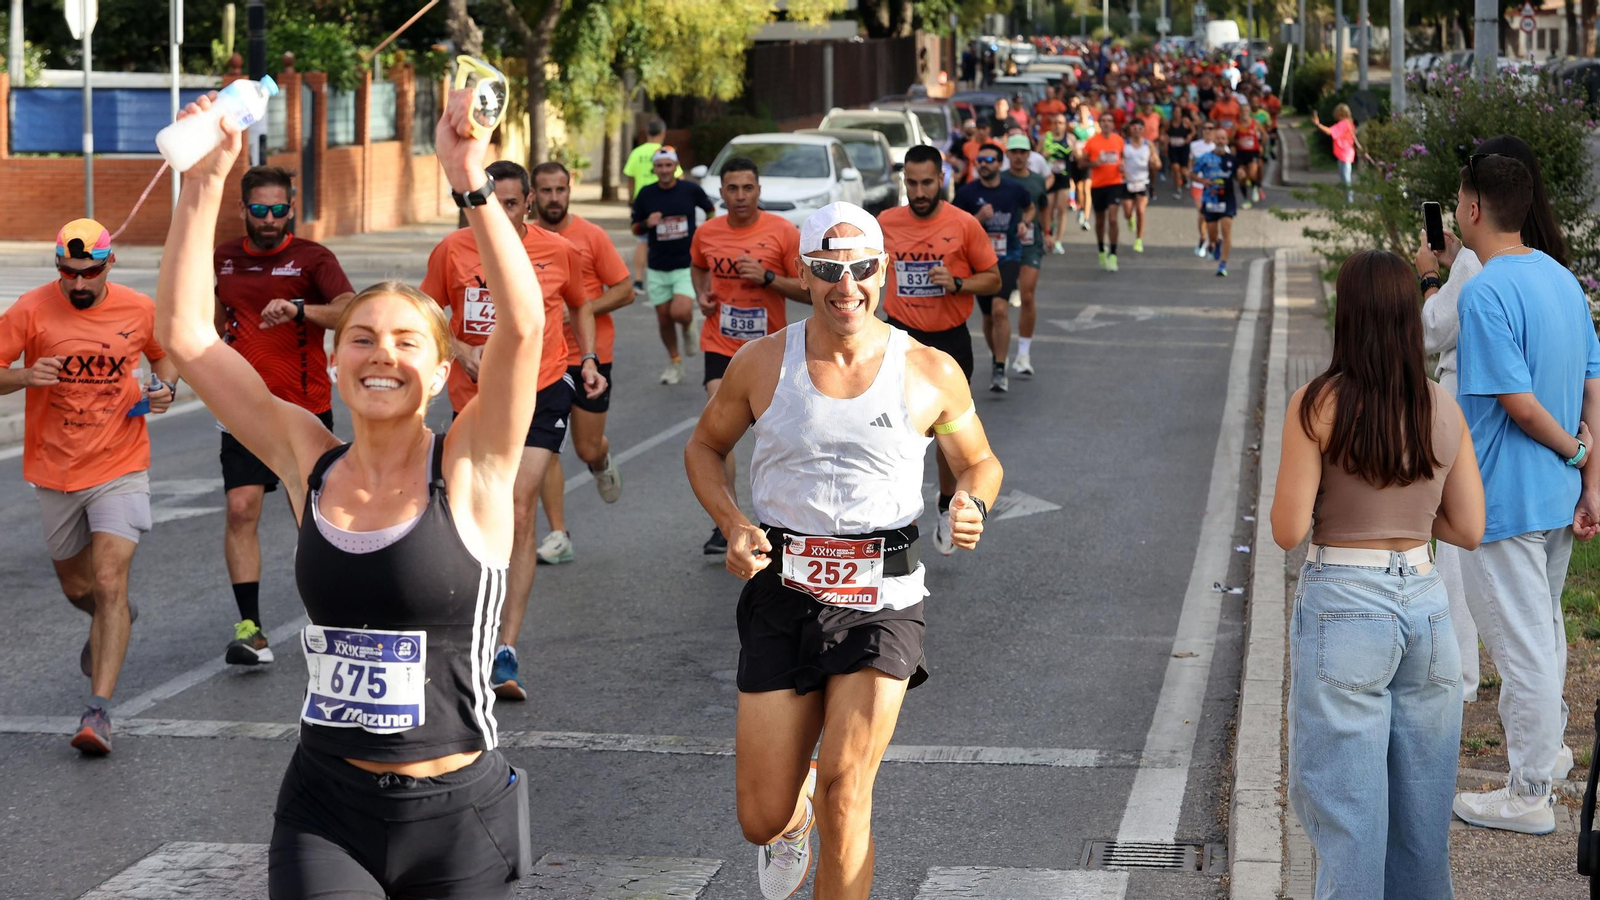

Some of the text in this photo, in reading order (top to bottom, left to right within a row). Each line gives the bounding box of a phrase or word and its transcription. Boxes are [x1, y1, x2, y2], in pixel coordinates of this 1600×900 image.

[907, 273, 930, 285] 837
[731, 318, 755, 330] 838
[807, 560, 858, 585] 252
[331, 661, 387, 699] 675
